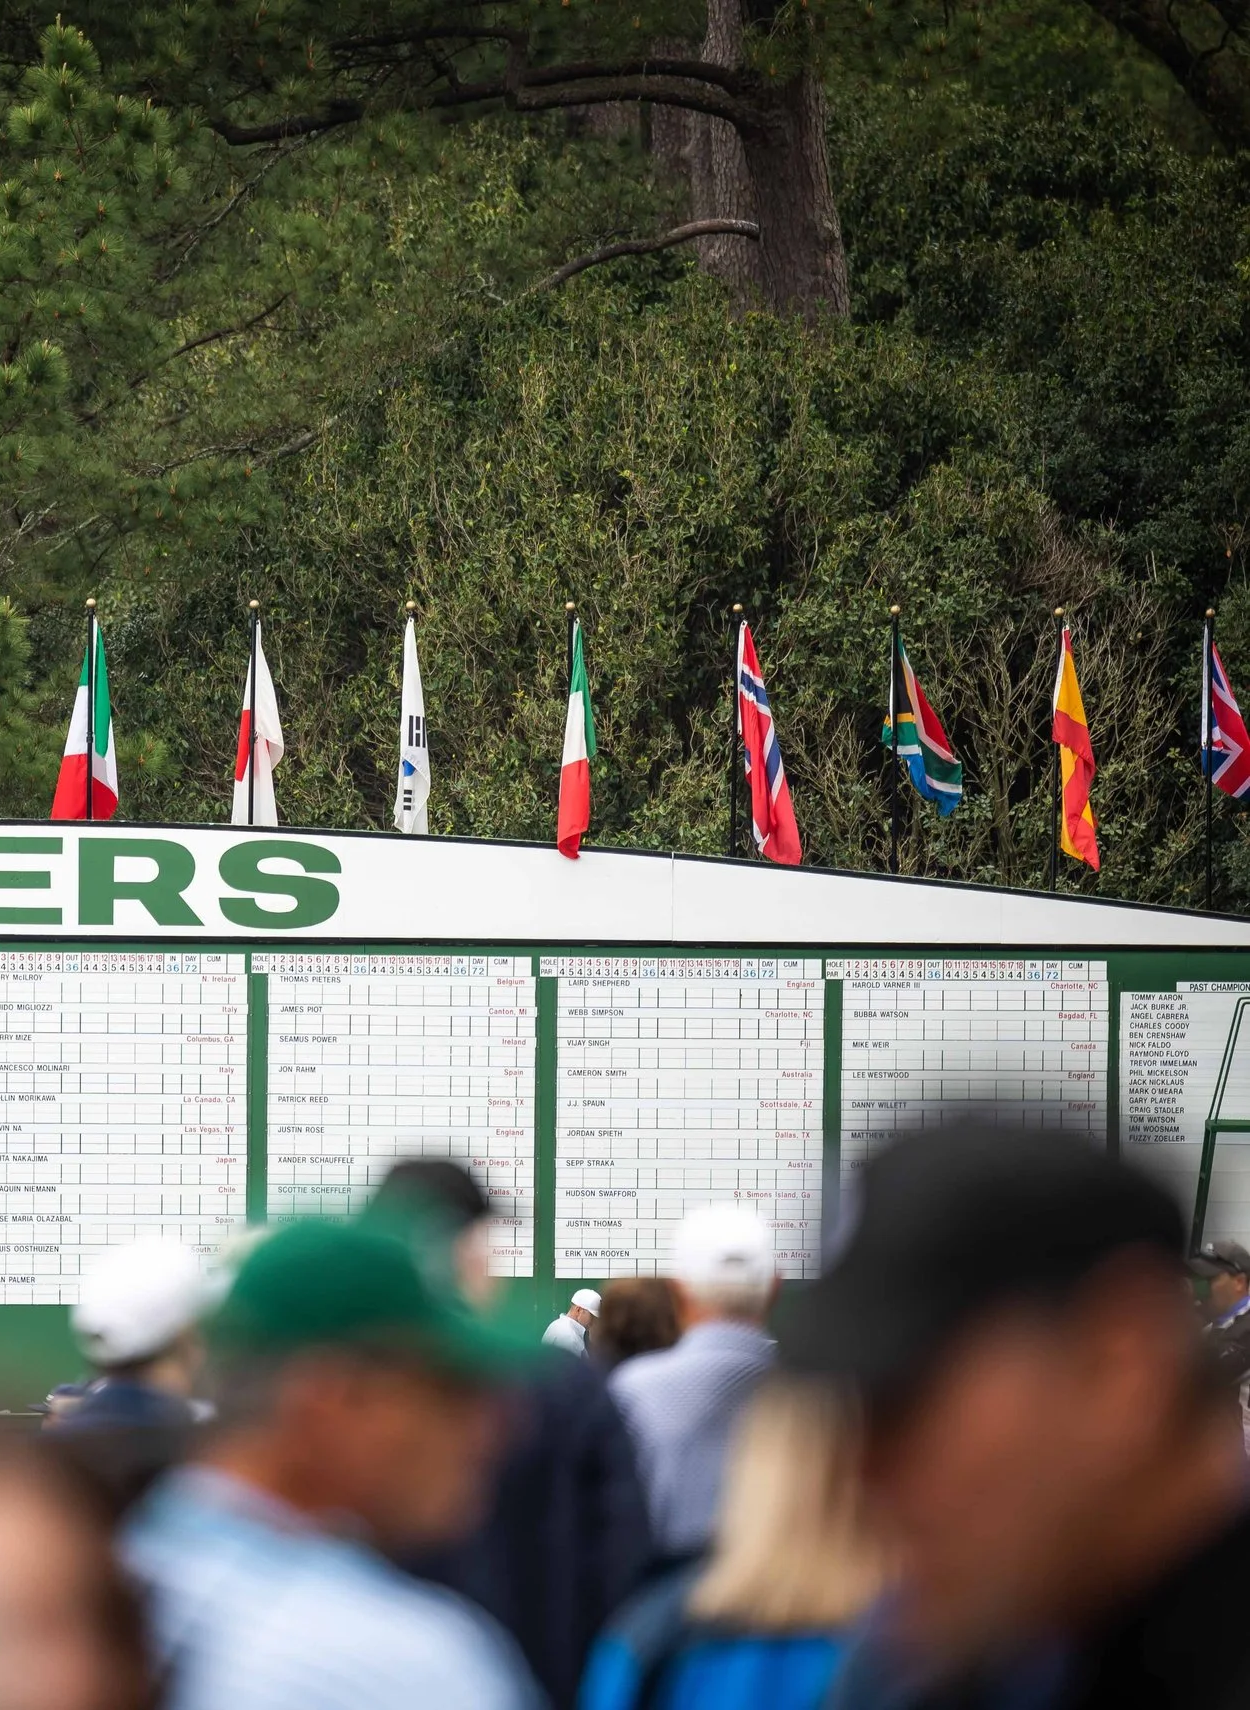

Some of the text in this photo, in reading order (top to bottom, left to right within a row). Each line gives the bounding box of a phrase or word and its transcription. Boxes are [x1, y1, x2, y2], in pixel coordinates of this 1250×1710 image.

[826, 960, 1083, 970] HOLE OUT IN DAY CUM
[13, 973, 42, 982] McILROY
[280, 975, 341, 984] THOMAS PIETERS
[826, 970, 1058, 980] PAR 36 36 72
[497, 978, 525, 987] Belgium
[569, 979, 630, 987] LAIRD SHEPHERD
[787, 980, 814, 990] England
[852, 981, 880, 989] HAROLD
[884, 981, 910, 989] VARNER
[1088, 982, 1098, 991] NC
[17, 1003, 52, 1012] MIGLIOZZI
[222, 1005, 237, 1015] Italy
[281, 1005, 322, 1014] JAMES PIOT
[568, 1009, 623, 1017] WEBB SIMPSON
[854, 1010, 908, 1019] BUBBA WATSON
[16, 1033, 31, 1042] MIZE
[280, 1035, 337, 1044] SEAMUS POWER
[502, 1038, 526, 1046] Ireland
[567, 1039, 609, 1047] VIJAY SINGH
[800, 1040, 810, 1049] Fiji
[853, 1041, 889, 1049] MIKE WEIR
[1071, 1042, 1096, 1051] Canada
[37, 1064, 69, 1072] MOLINARI
[279, 1065, 315, 1074] JON RAHM
[504, 1068, 523, 1078] Spain
[567, 1069, 626, 1077] CAMERON SMITH
[782, 1071, 812, 1079] Australia
[852, 1071, 909, 1079] LEE WESTWOOD
[1068, 1071, 1094, 1081] England
[19, 1094, 55, 1102] MORIKAWA
[278, 1096, 328, 1104] PATRICK REED
[567, 1099, 605, 1108] J.J. SPAUN
[278, 1126, 324, 1134] JUSTIN ROSE
[496, 1128, 524, 1138] England
[567, 1129, 622, 1138] JORDAN SPIETH
[13, 1154, 48, 1163] NAKAJIMA
[216, 1156, 236, 1165] Japan
[278, 1156, 354, 1164] XANDER SCHAUFFELE
[566, 1159, 614, 1167] SEPP STRAKA
[788, 1161, 812, 1169] Austria
[24, 1185, 56, 1193] NIEMANN
[218, 1186, 236, 1194] Chile
[278, 1186, 351, 1194] SCOTTIE SCHEFFLER
[566, 1189, 636, 1198] HUDSON SWAFFORD
[12, 1215, 33, 1223] MARIA
[36, 1215, 72, 1223] OLAZABAL
[215, 1216, 234, 1225] Spain
[566, 1220, 622, 1228] JUSTIN THOMAS
[14, 1245, 59, 1253] OOSTHUIZEN
[9, 1275, 35, 1284] PALMER
